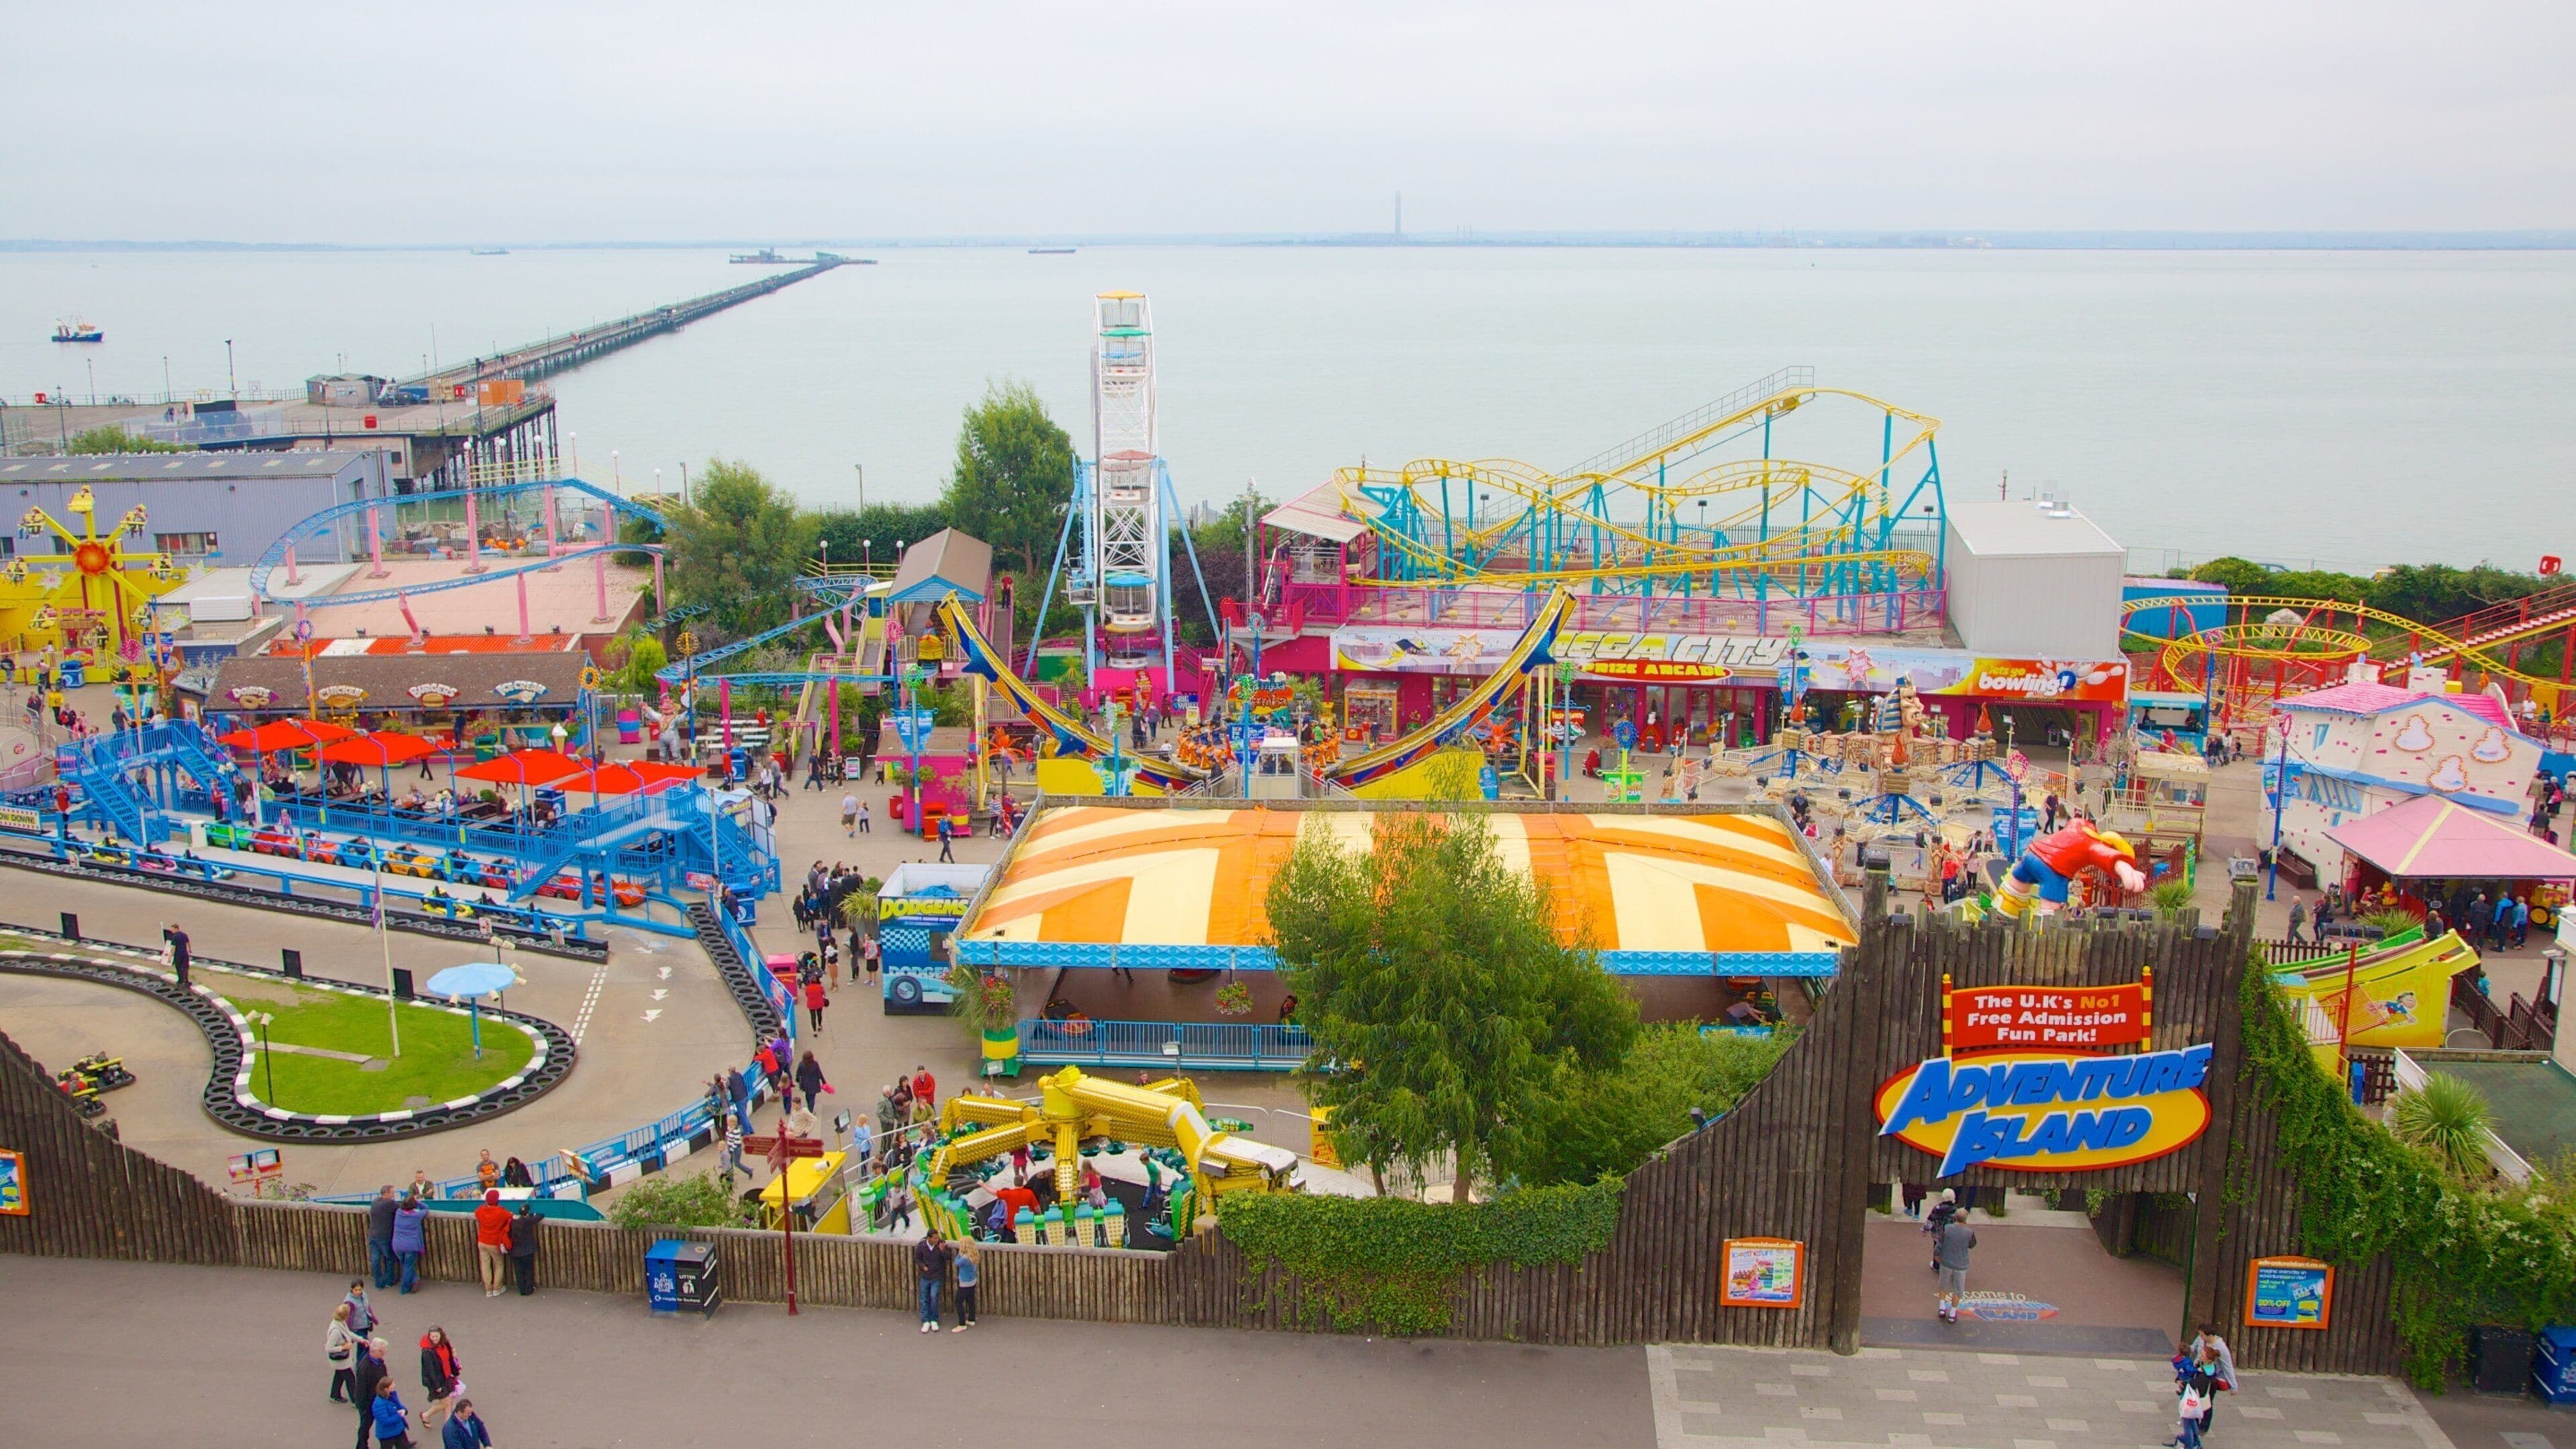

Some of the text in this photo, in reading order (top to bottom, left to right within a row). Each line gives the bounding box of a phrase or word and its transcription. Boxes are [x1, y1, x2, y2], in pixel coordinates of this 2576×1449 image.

[1670, 635, 1789, 665] CITY
[1582, 661, 1725, 678] PRIZE ARCADE
[2010, 666, 2026, 677] go
[407, 682, 458, 699] BURGERS
[494, 680, 547, 697] ICE CREAM
[1978, 671, 2070, 696] bowling!
[231, 686, 271, 698] DONUTS
[318, 685, 364, 700] CHICKEN
[1177, 695, 1189, 704] BIG
[528, 737, 545, 747] real
[879, 898, 969, 921] DODGEMS
[1974, 994, 2119, 1010] The U.K's No1
[1968, 1011, 2127, 1026] Free Admission
[1997, 1028, 2097, 1042] Fun Park!
[1878, 1042, 2213, 1136] ADVENTURE
[1936, 1106, 2153, 1179] ISLAND
